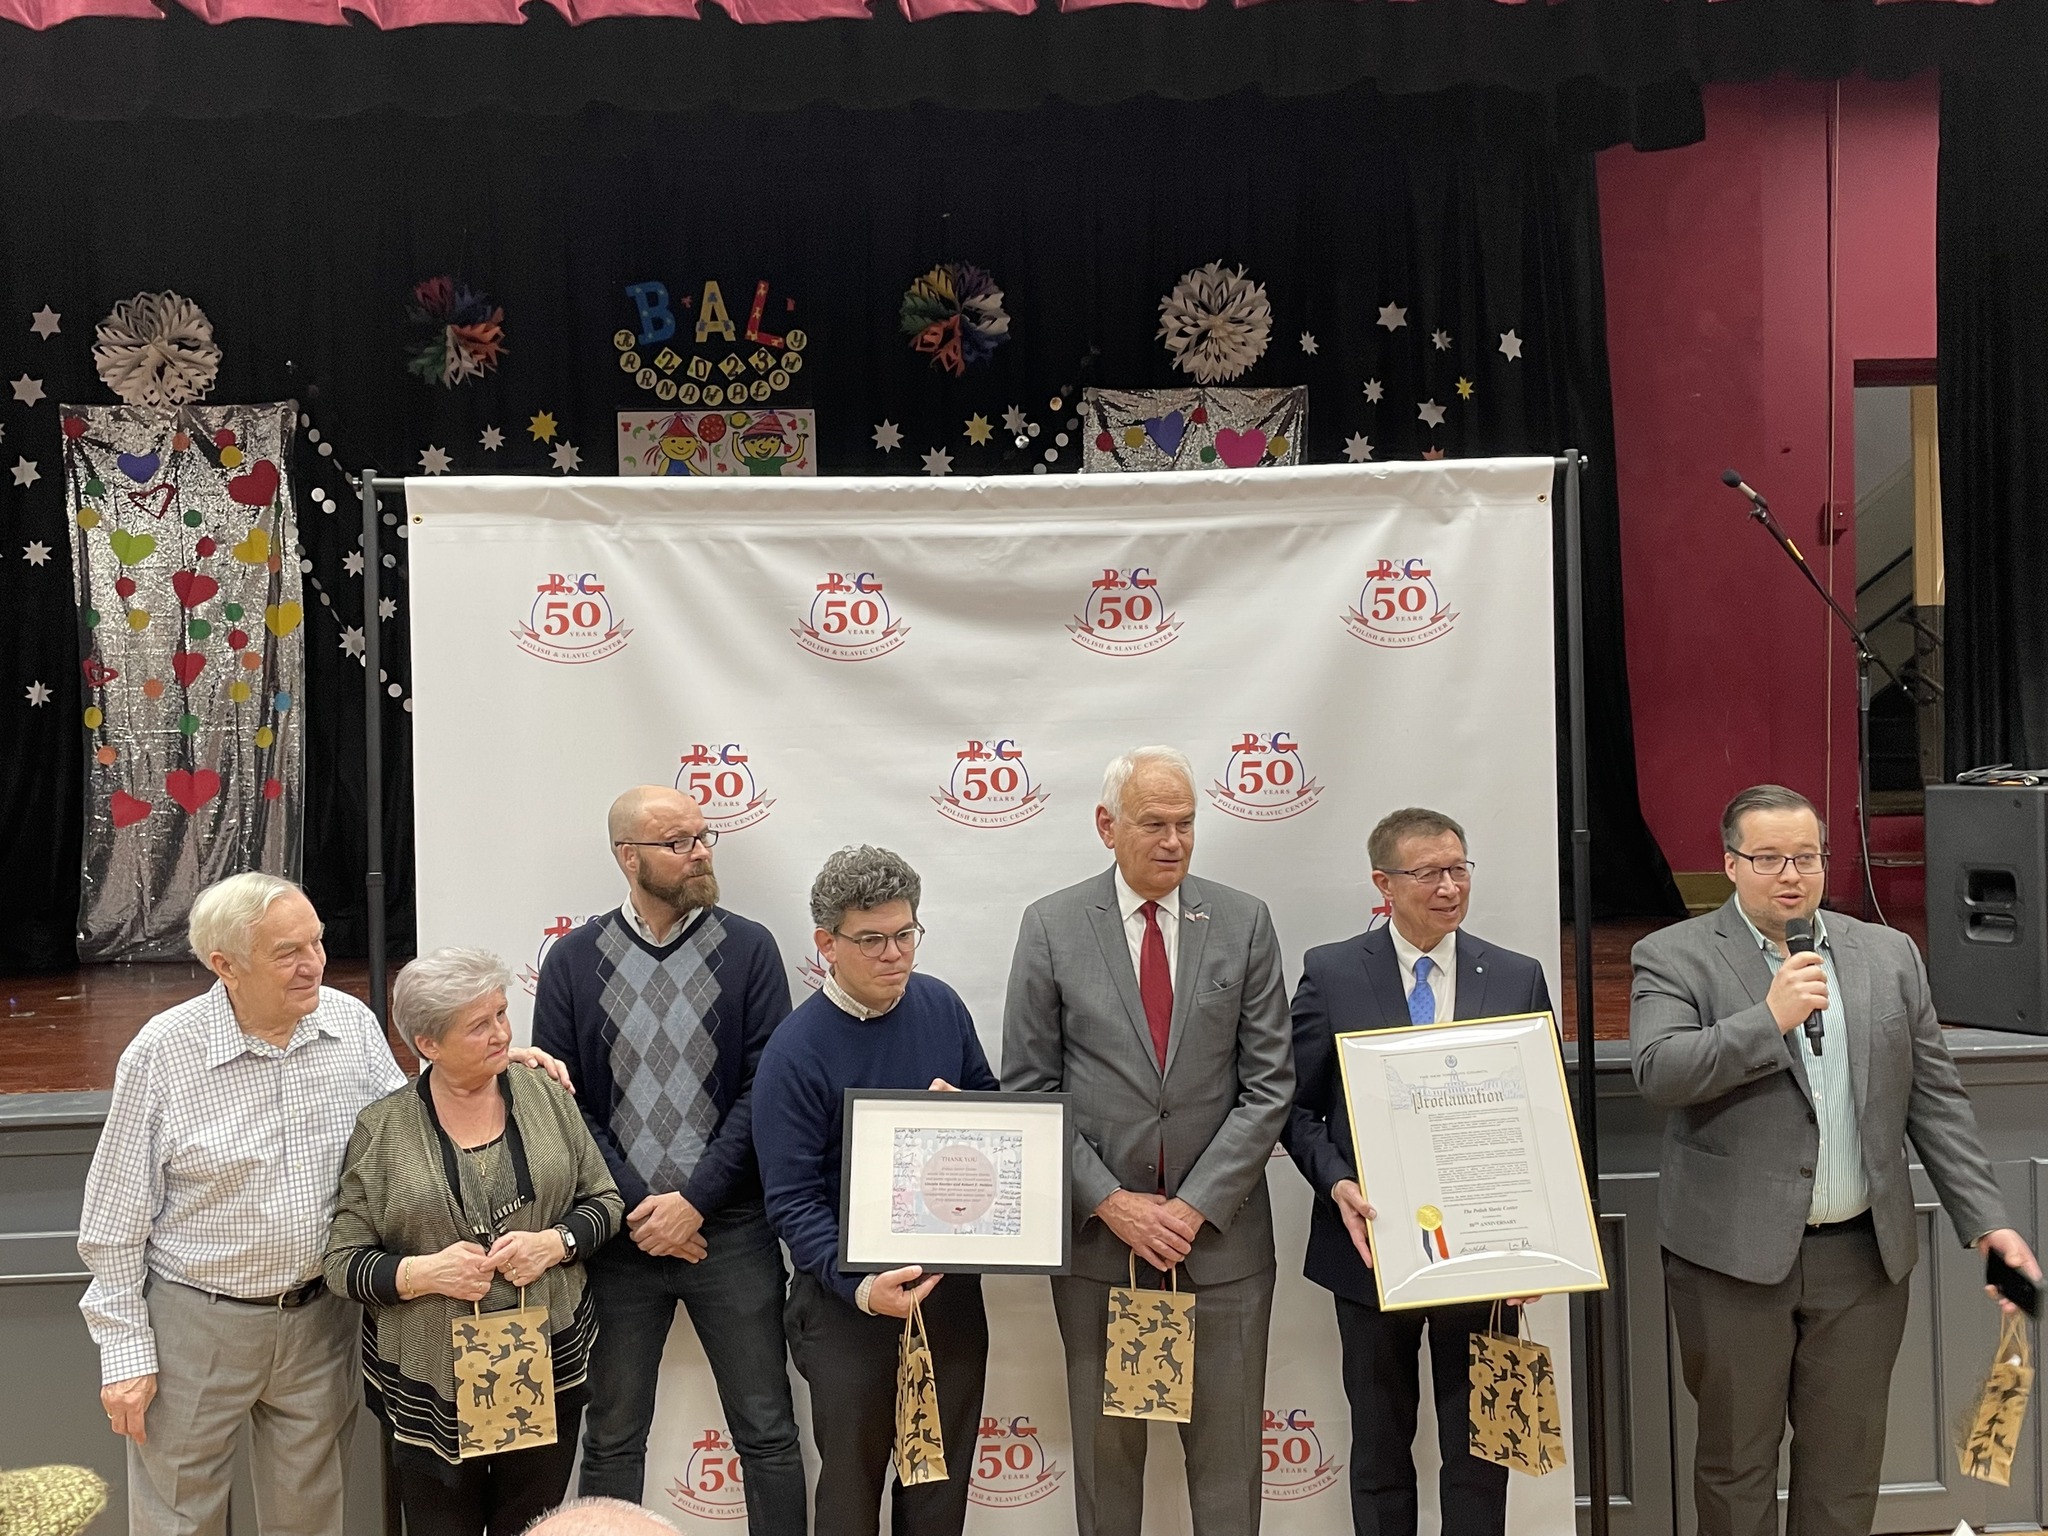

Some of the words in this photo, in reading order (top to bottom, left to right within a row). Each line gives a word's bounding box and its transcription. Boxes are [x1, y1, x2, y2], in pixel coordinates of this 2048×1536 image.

[625, 280, 785, 349] BAL
[658, 349, 773, 380] 2023
[823, 600, 878, 634] 50
[1098, 595, 1152, 629] 50
[1372, 586, 1427, 620] 50
[544, 602, 601, 635] 50
[1352, 625, 1378, 640] POLISH
[1418, 623, 1448, 640] CENTER
[523, 640, 551, 656] POLISH
[593, 640, 623, 656] CENTER
[802, 637, 830, 653] POLISH
[870, 637, 900, 653] CENTER
[1077, 634, 1104, 648] POLISH
[1144, 632, 1173, 648] CENTER
[690, 772, 743, 806] 50
[963, 767, 1018, 801] 50
[1239, 760, 1294, 794] 50
[735, 809, 765, 825] CENTER
[942, 805, 970, 820] POLISH
[1010, 804, 1039, 820] CENTER
[1218, 799, 1246, 813] POLISH
[1285, 797, 1314, 813] CENTER
[1412, 1088, 1504, 1114] Proclamation
[978, 1444, 1033, 1479] 50
[1262, 1438, 1311, 1472] 50
[1025, 1482, 1054, 1499] CENTER
[1302, 1476, 1332, 1492] CENTER
[678, 1498, 705, 1512] POLISH
